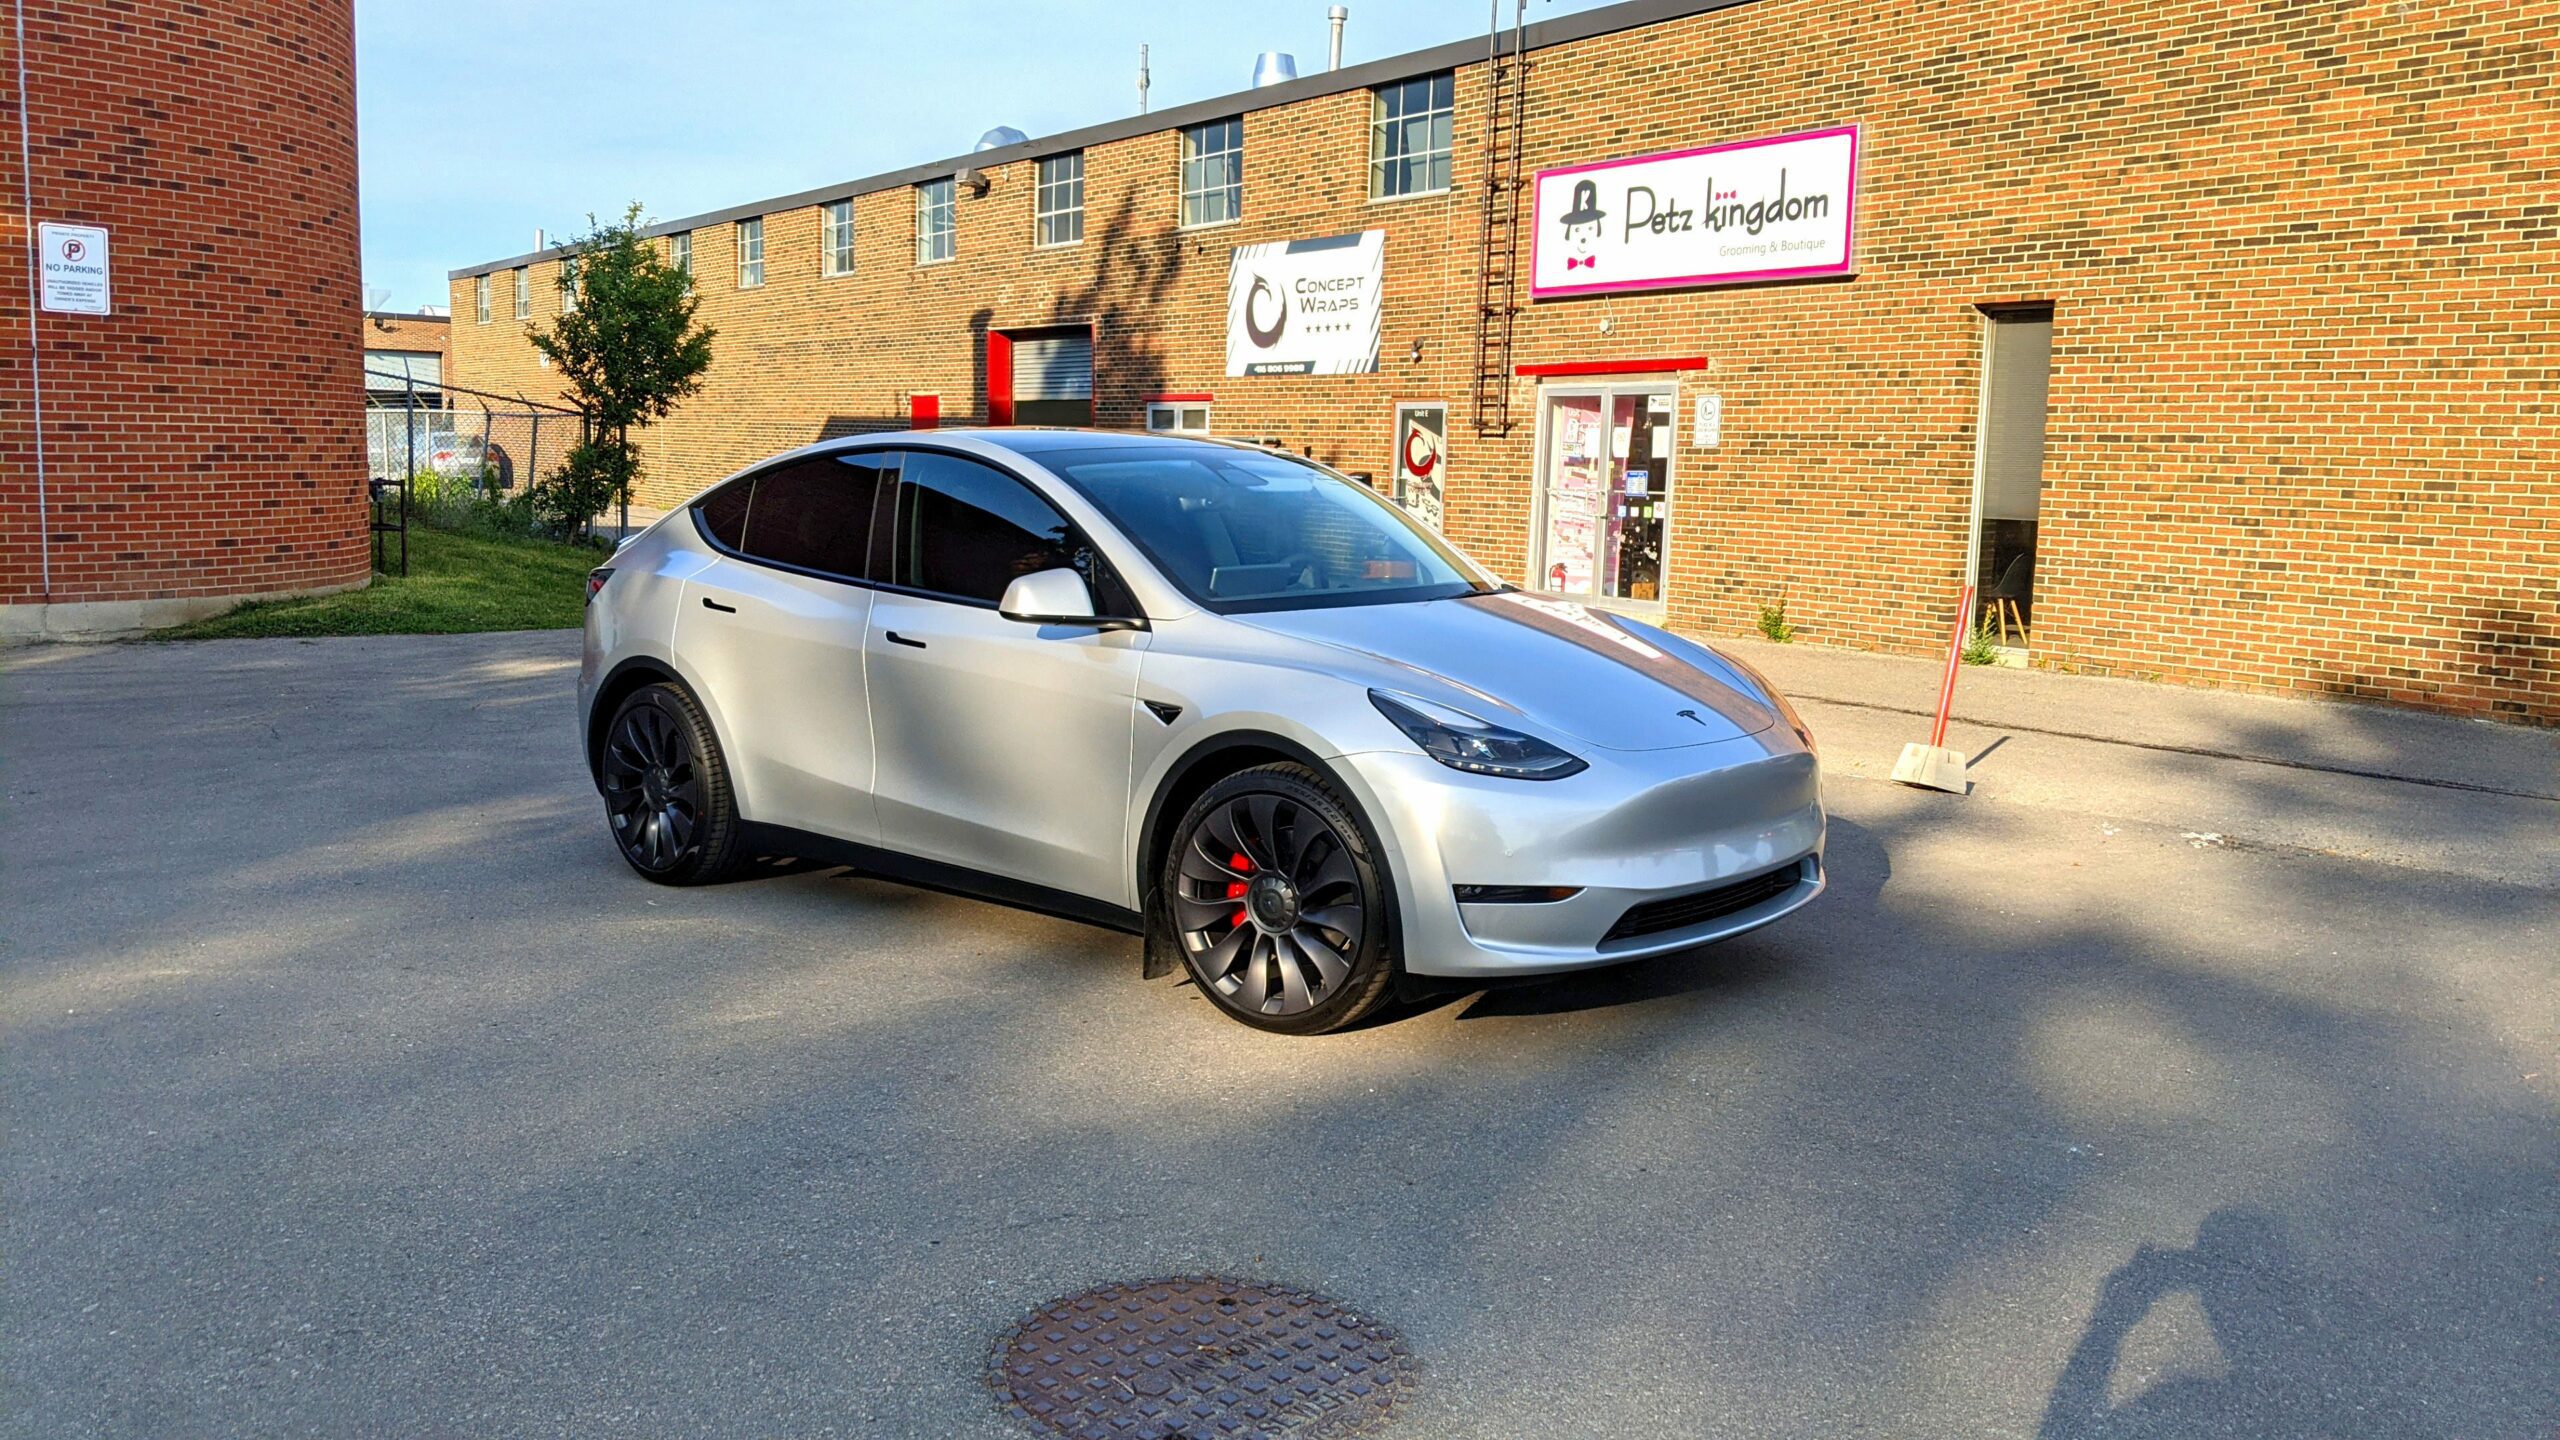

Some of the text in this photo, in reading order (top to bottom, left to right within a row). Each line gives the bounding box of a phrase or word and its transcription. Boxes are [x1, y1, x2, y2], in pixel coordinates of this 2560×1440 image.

[1624, 167, 1829, 244] Petz kingdom
[1719, 238, 1826, 257] Grooming & Boutique
[45, 263, 103, 275] NO PARKING
[1295, 276, 1365, 294] CONCEPT
[1300, 296, 1359, 314] WRAPS
[1424, 409, 1429, 418] E
